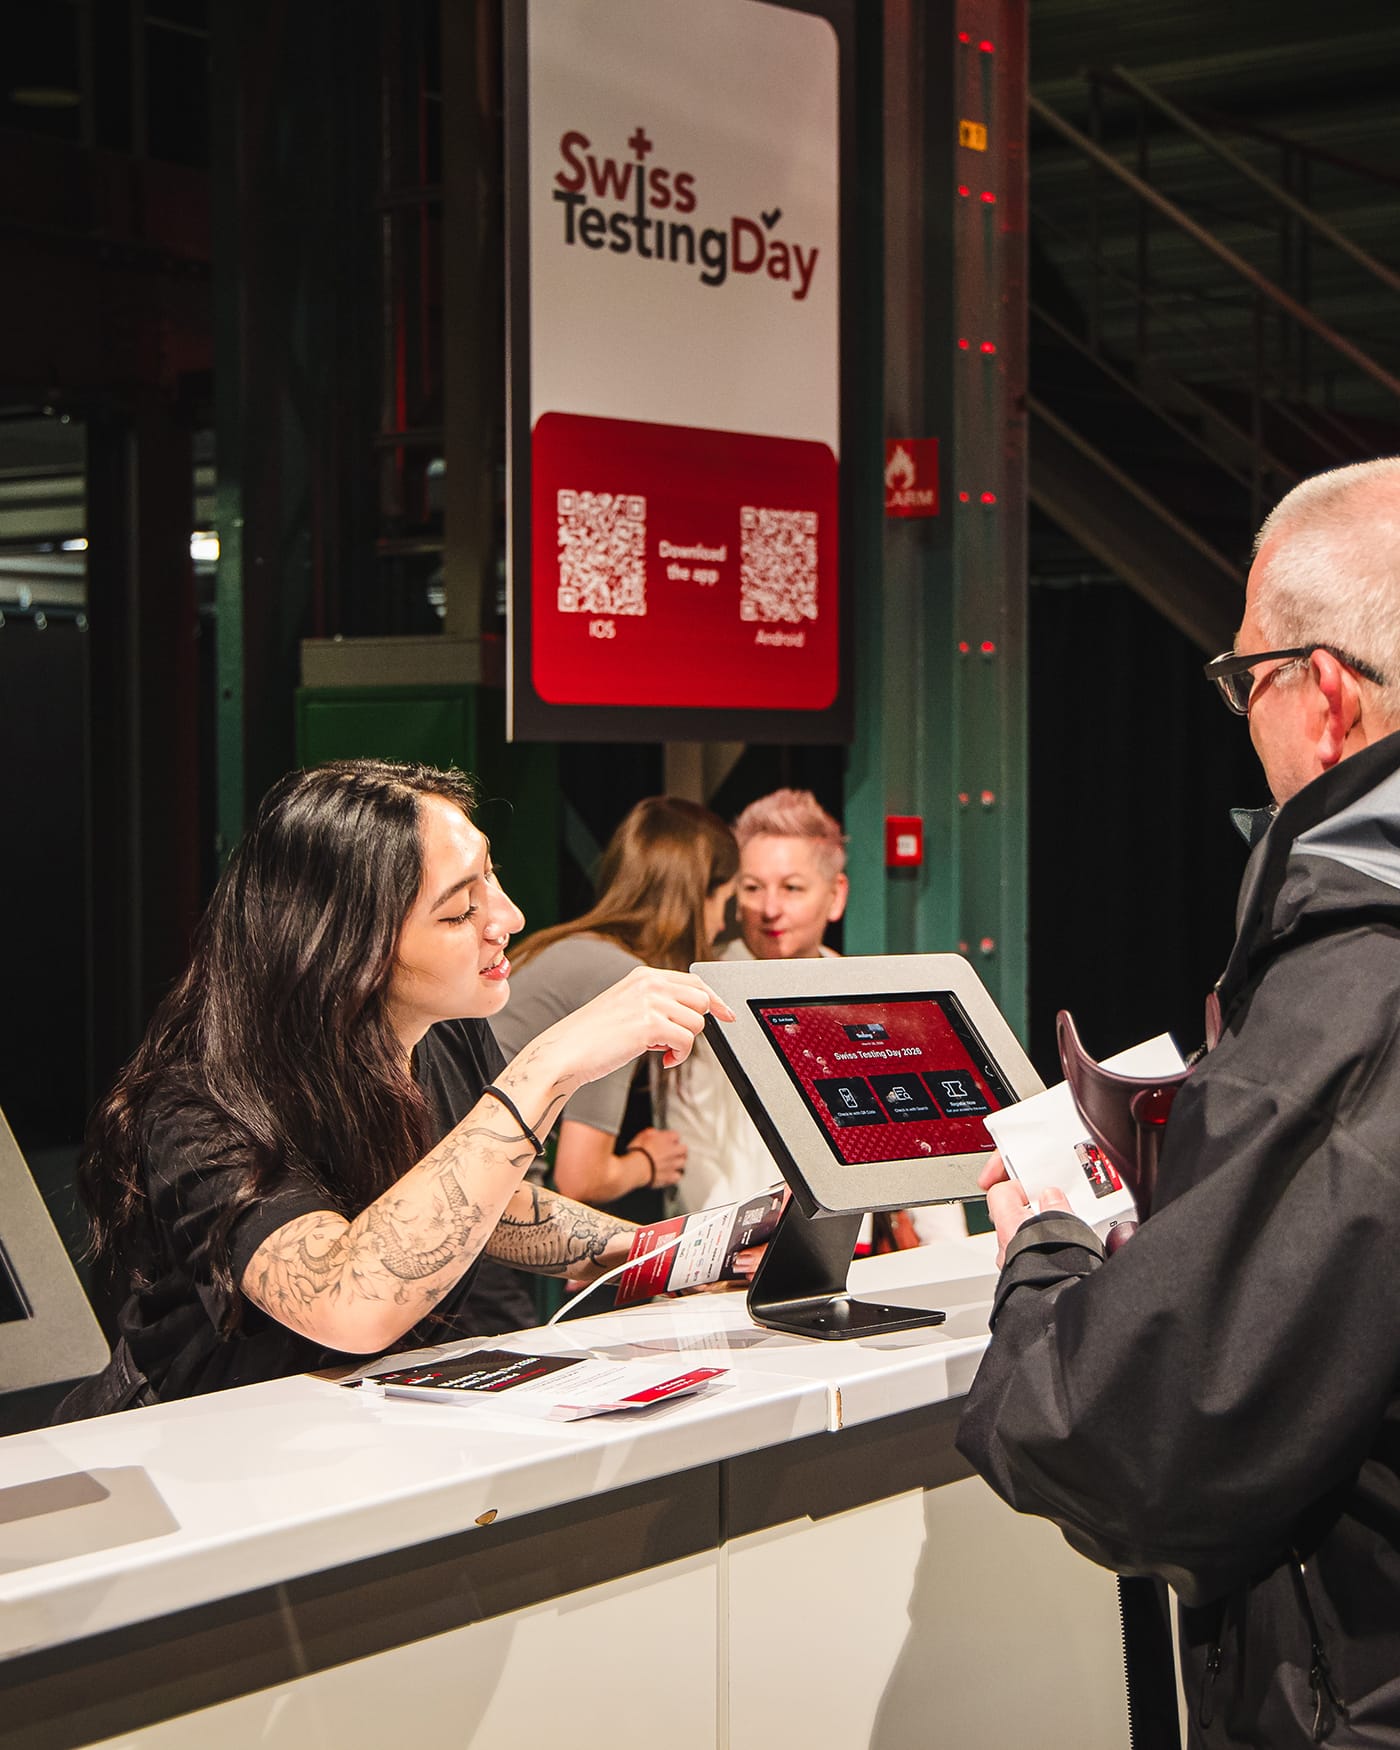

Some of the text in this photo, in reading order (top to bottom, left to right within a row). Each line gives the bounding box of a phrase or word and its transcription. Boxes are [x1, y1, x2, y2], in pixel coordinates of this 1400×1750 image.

[554, 127, 697, 214] Swiss
[834, 1051, 858, 1061] Swiss
[857, 1049, 887, 1060] Testing
[885, 1048, 902, 1058] Day
